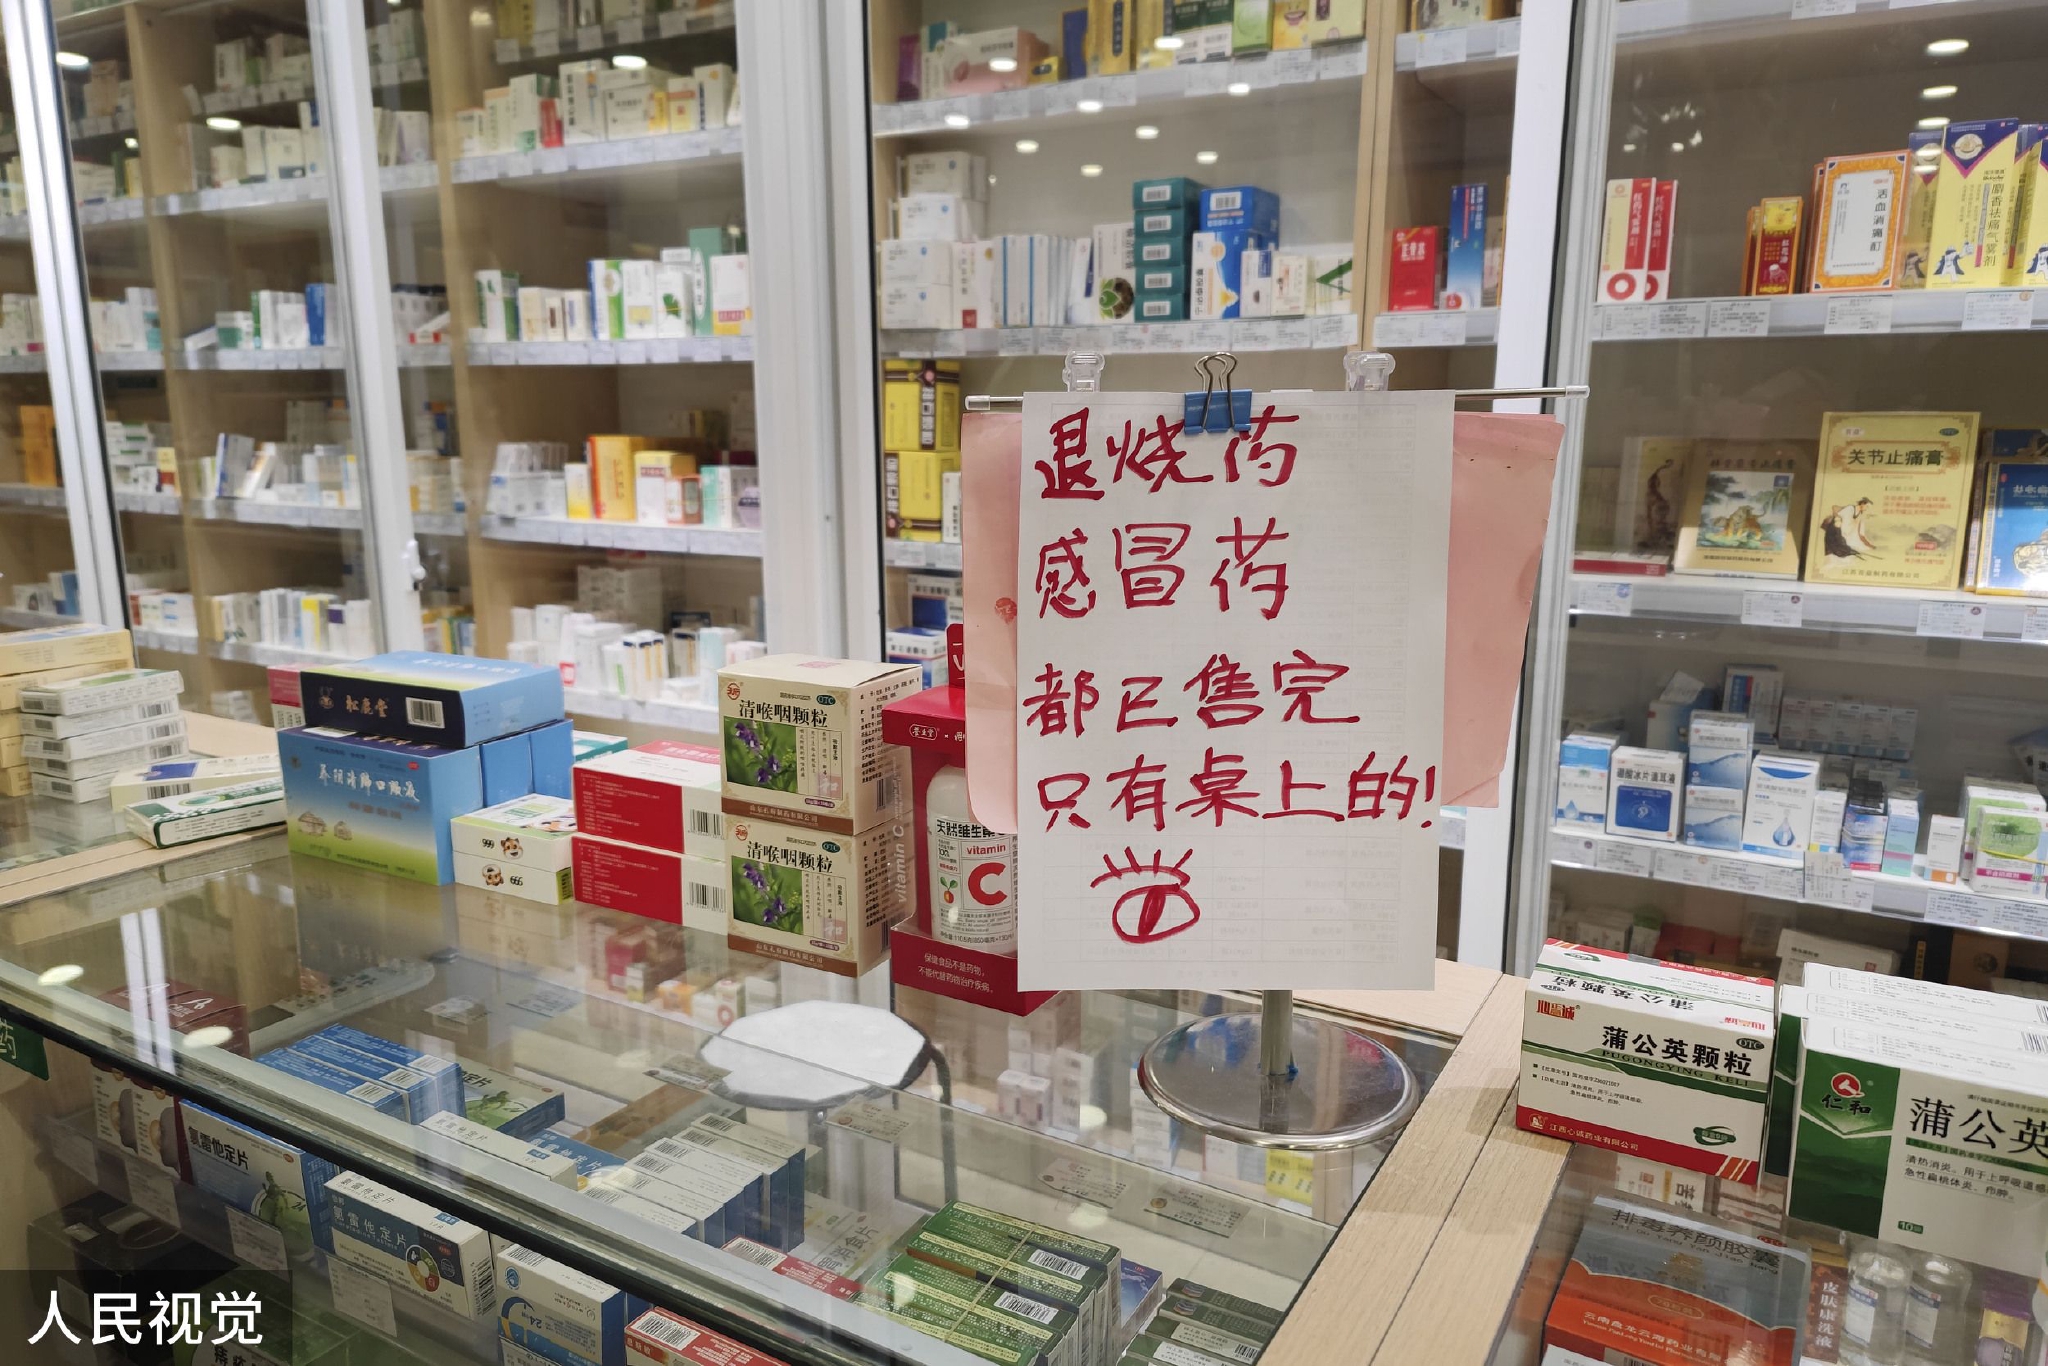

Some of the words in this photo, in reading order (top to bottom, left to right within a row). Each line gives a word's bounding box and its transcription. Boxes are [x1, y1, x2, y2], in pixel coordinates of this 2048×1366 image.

[1034, 405, 1300, 501] 退烧药
[1847, 449, 1945, 466] 关节止痛膏
[1036, 517, 1290, 621] 感冒药
[818, 695, 836, 706] OTC
[1022, 649, 1361, 738] 都已售完
[739, 699, 829, 729] 清喉咽颗粒
[481, 838, 495, 849] 999
[747, 841, 833, 873] 清喉咽颗粒
[966, 844, 1006, 855] vitamin
[967, 861, 1008, 906] C
[1601, 1025, 1752, 1076] 蒲公英颗粒
[1737, 1039, 1762, 1050] OTC
[1602, 1050, 1704, 1079] PUGONGYING
[1714, 1072, 1751, 1087] KELI
[1821, 1094, 1872, 1115] 仁和
[1549, 1123, 1639, 1152] 江西心诚药业有限公司
[1906, 1096, 2048, 1159] 蒲公英
[1611, 1208, 1781, 1269] 排毒养颜胶囊
[1815, 1281, 1839, 1349] 皮肤康洗液
